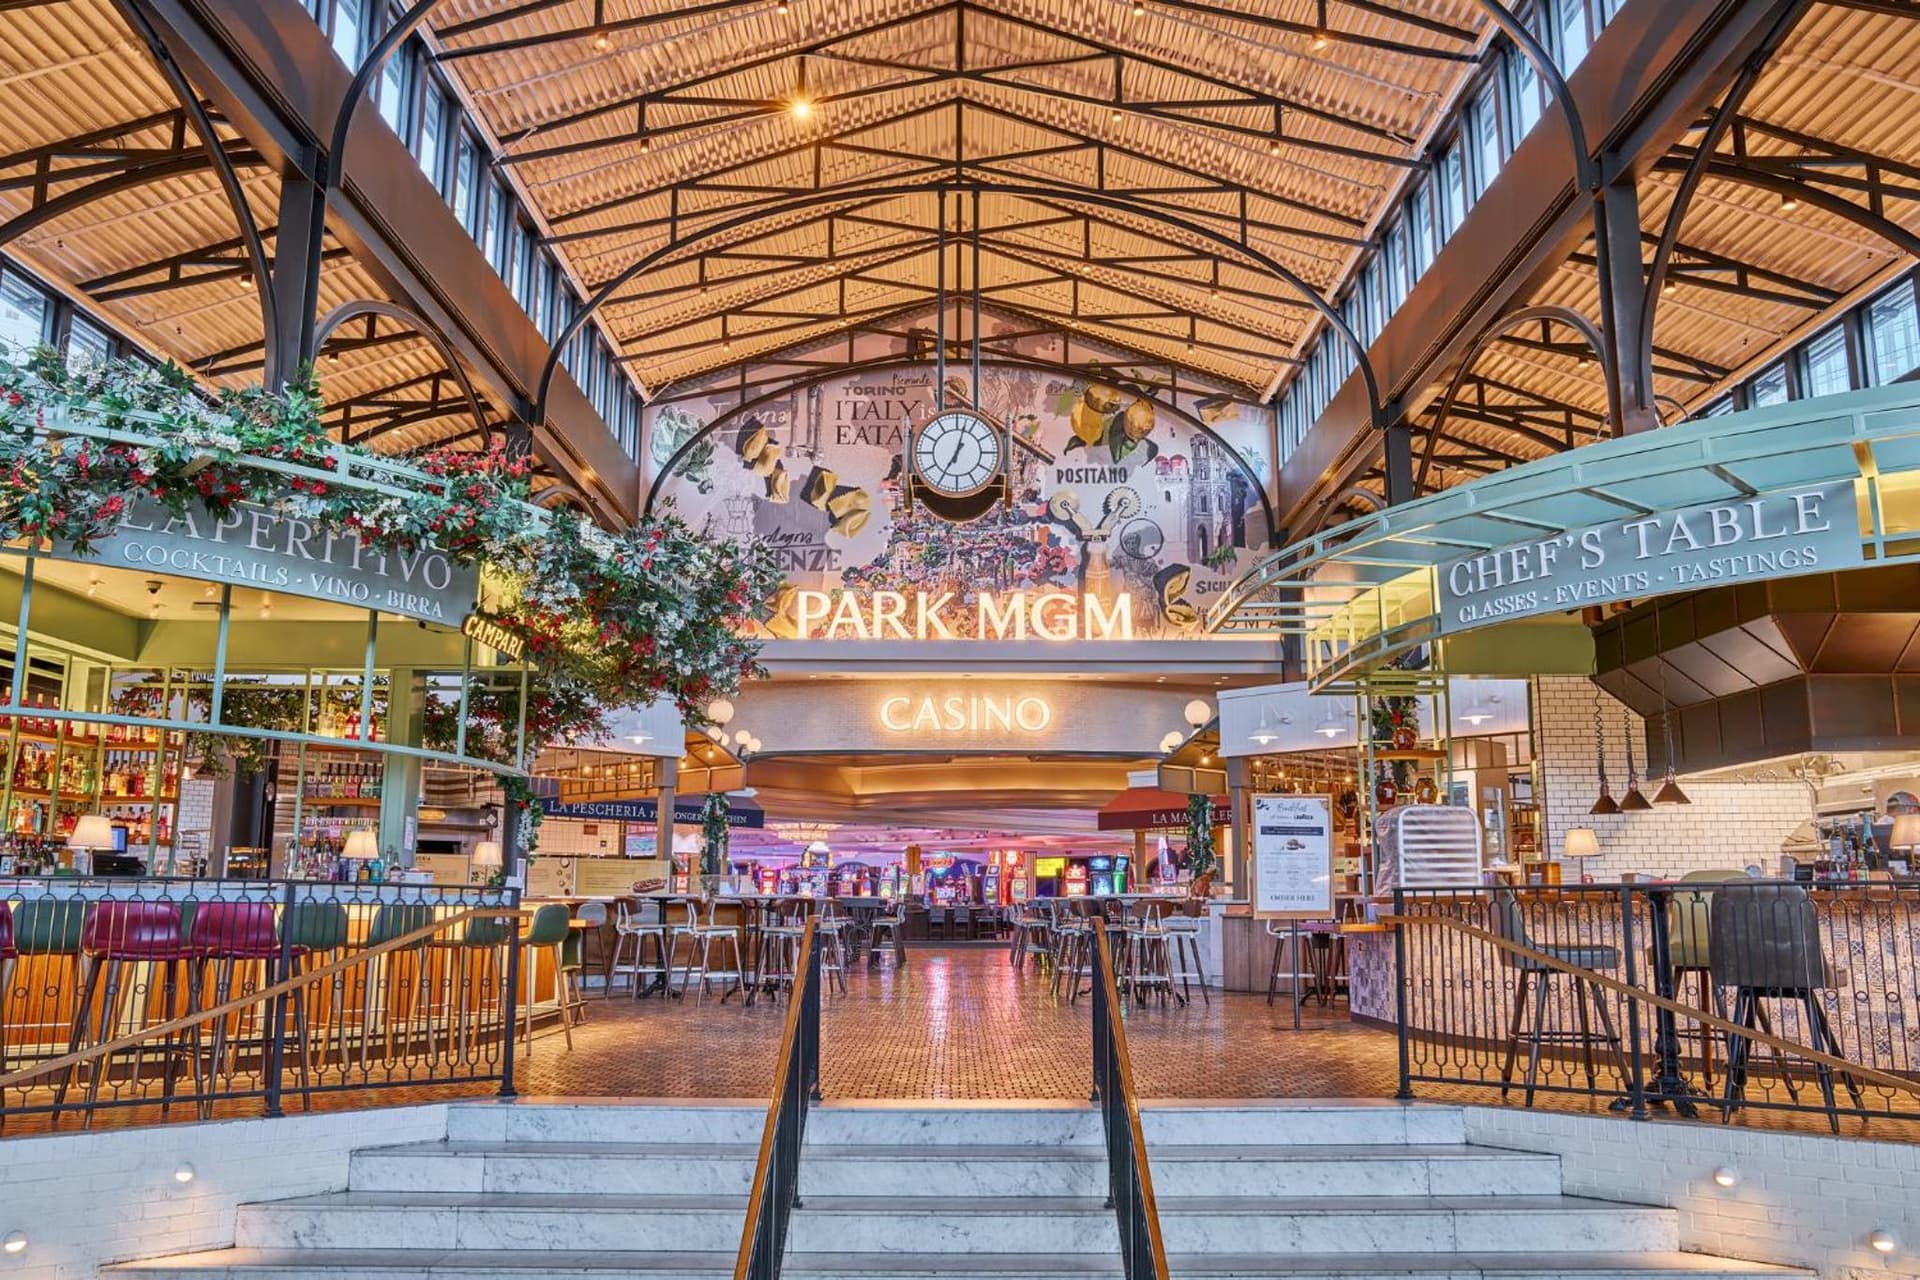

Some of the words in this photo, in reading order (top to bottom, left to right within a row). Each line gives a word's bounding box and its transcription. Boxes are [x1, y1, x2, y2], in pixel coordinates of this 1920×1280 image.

[842, 386, 906, 396] TORINO
[836, 400, 921, 420] ITALY
[919, 403, 936, 420] is
[1056, 467, 1128, 484] POSITANO
[1623, 490, 1832, 561] TABLE
[124, 541, 289, 587] COCKTAILS
[311, 573, 370, 601] VINO
[387, 589, 444, 619] BIRRA
[1458, 591, 1538, 625] CLASSES
[1555, 570, 1650, 605] EVENTS
[1670, 545, 1820, 584] TASTINGS
[797, 590, 956, 641] PARK
[977, 592, 1133, 642] MGM
[464, 616, 525, 659] CAMPARI
[879, 696, 1052, 733] CASINO
[549, 801, 568, 813] LA
[571, 803, 647, 818] PESCHERIA
[1152, 813, 1168, 824] LA
